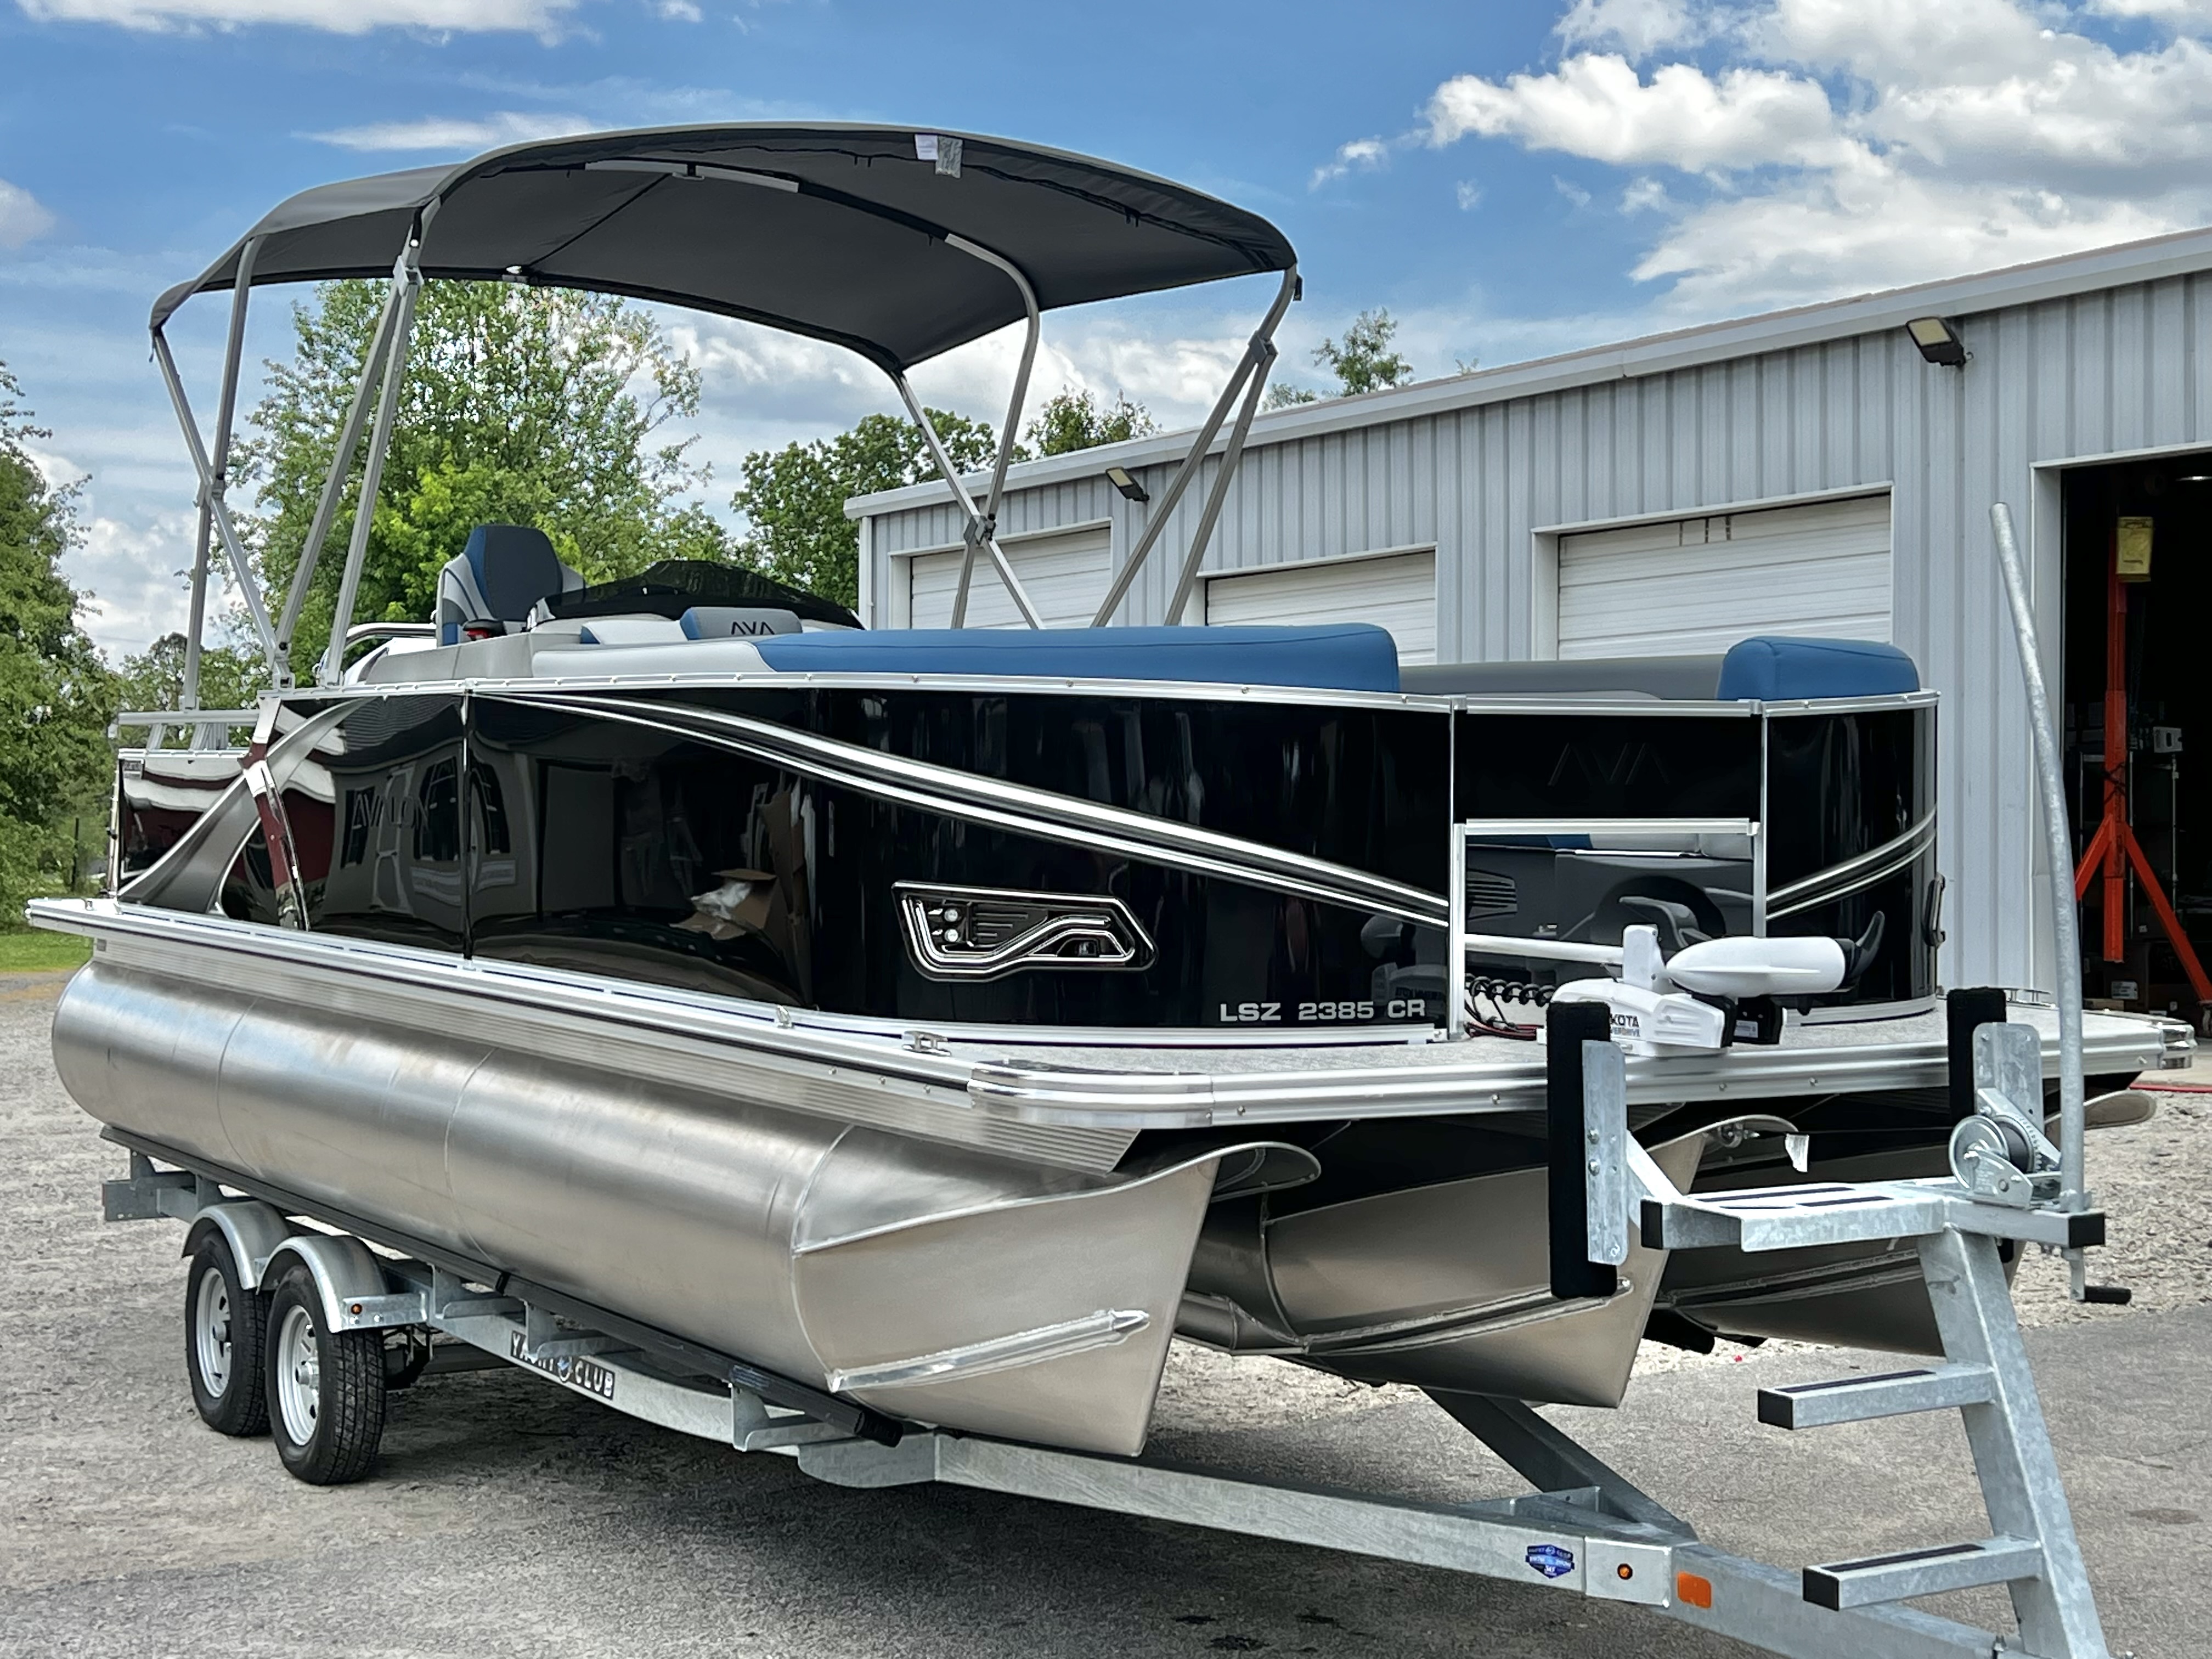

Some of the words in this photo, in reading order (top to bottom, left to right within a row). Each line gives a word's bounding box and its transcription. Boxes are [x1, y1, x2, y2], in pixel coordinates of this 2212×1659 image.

[731, 621, 775, 635] AVA
[1220, 1003, 1281, 1022] LSZ
[1298, 1001, 1374, 1020] 2385
[1387, 998, 1426, 1018] CR
